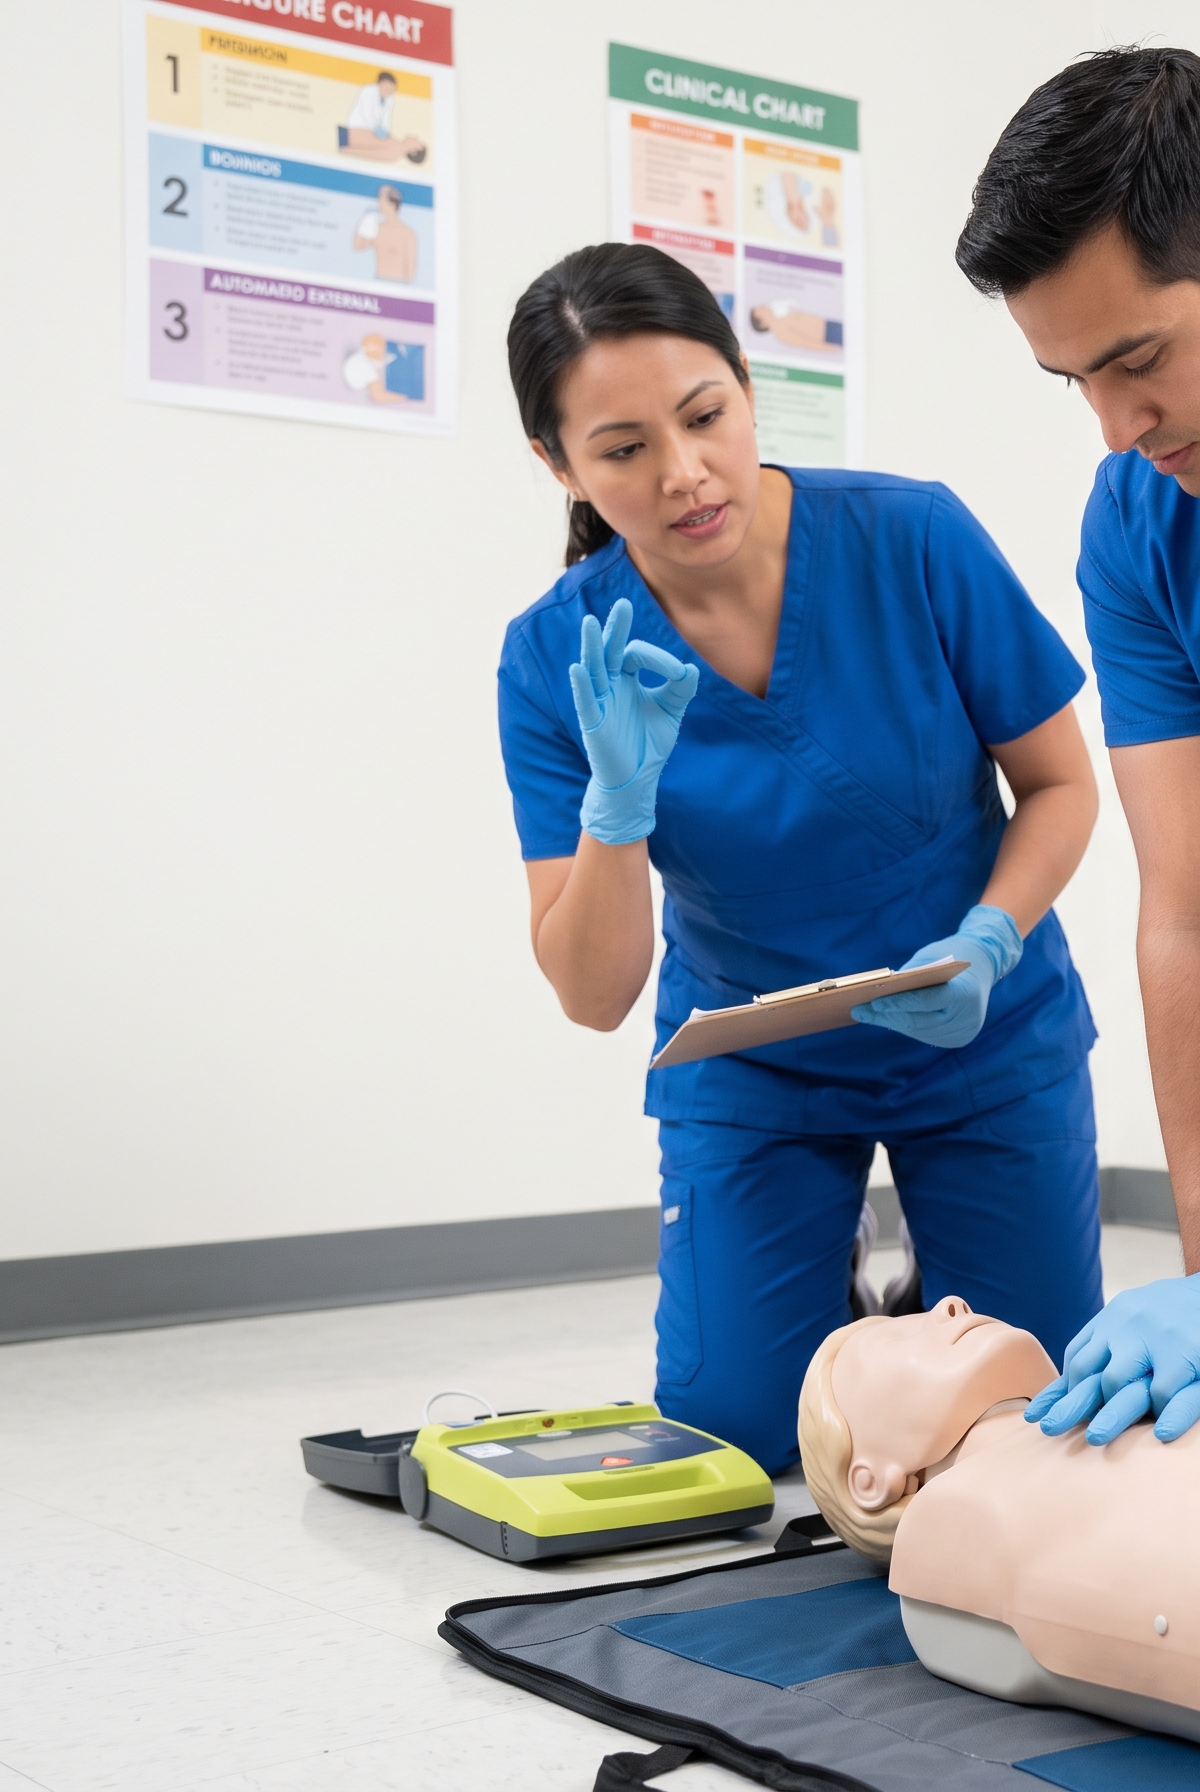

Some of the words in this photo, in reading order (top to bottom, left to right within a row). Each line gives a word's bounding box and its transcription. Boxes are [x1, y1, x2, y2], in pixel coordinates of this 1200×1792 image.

[332, 2, 424, 44] CHART
[165, 55, 180, 94] 1
[644, 68, 750, 114] CLINICAL
[752, 93, 826, 131] CHART
[162, 177, 188, 217] 2
[307, 287, 382, 314] EXTERNAL
[163, 301, 189, 341] 3
